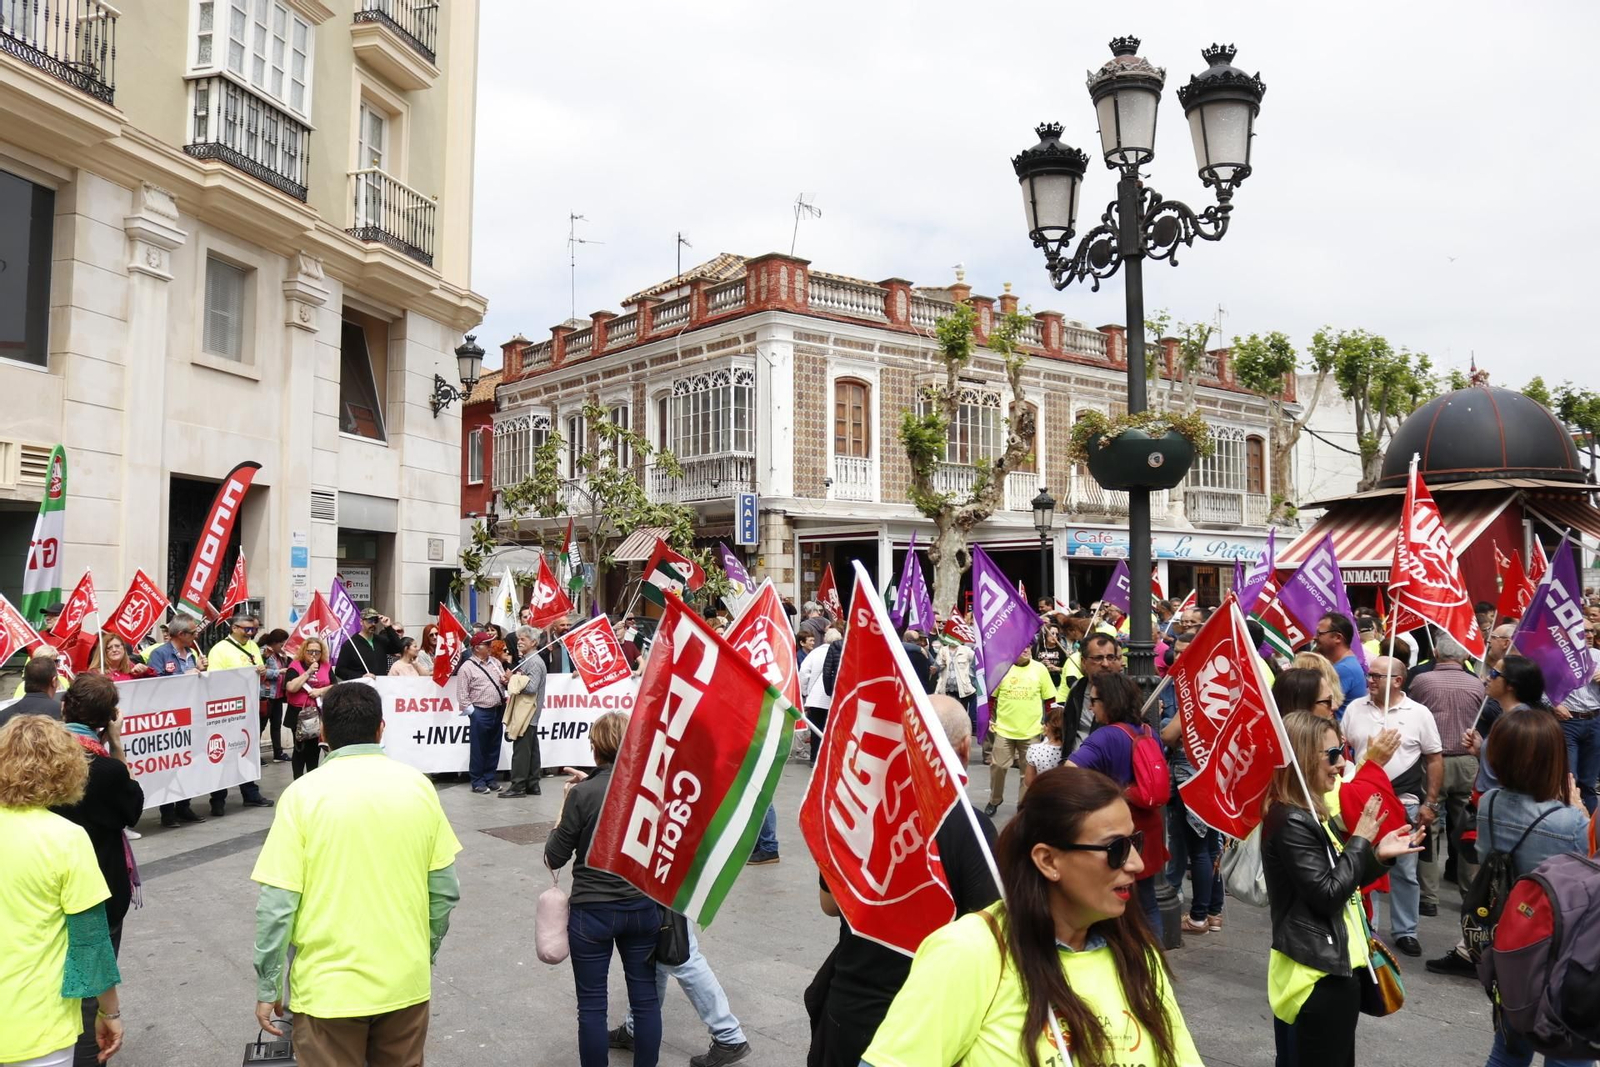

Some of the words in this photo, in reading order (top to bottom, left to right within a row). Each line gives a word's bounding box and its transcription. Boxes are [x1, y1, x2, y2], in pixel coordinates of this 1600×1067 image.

[744, 497, 752, 540] CAFE
[191, 478, 244, 592] CCOO
[1074, 530, 1113, 545] Café
[567, 541, 581, 568] SAHARA
[1173, 536, 1192, 557] La
[1203, 540, 1265, 559] Para
[1343, 569, 1391, 584] INMACUL
[1296, 574, 1326, 607] servicios
[595, 633, 614, 663] UGT
[1547, 624, 1583, 680] Andalucía
[588, 668, 628, 689] www.UGT.es
[395, 697, 454, 713] BASTA
[544, 692, 635, 709] IMINACIÓ
[121, 711, 177, 734] TINÚA
[537, 722, 594, 740] +EMP
[127, 750, 192, 776] SONAS
[828, 698, 906, 864] UGT
